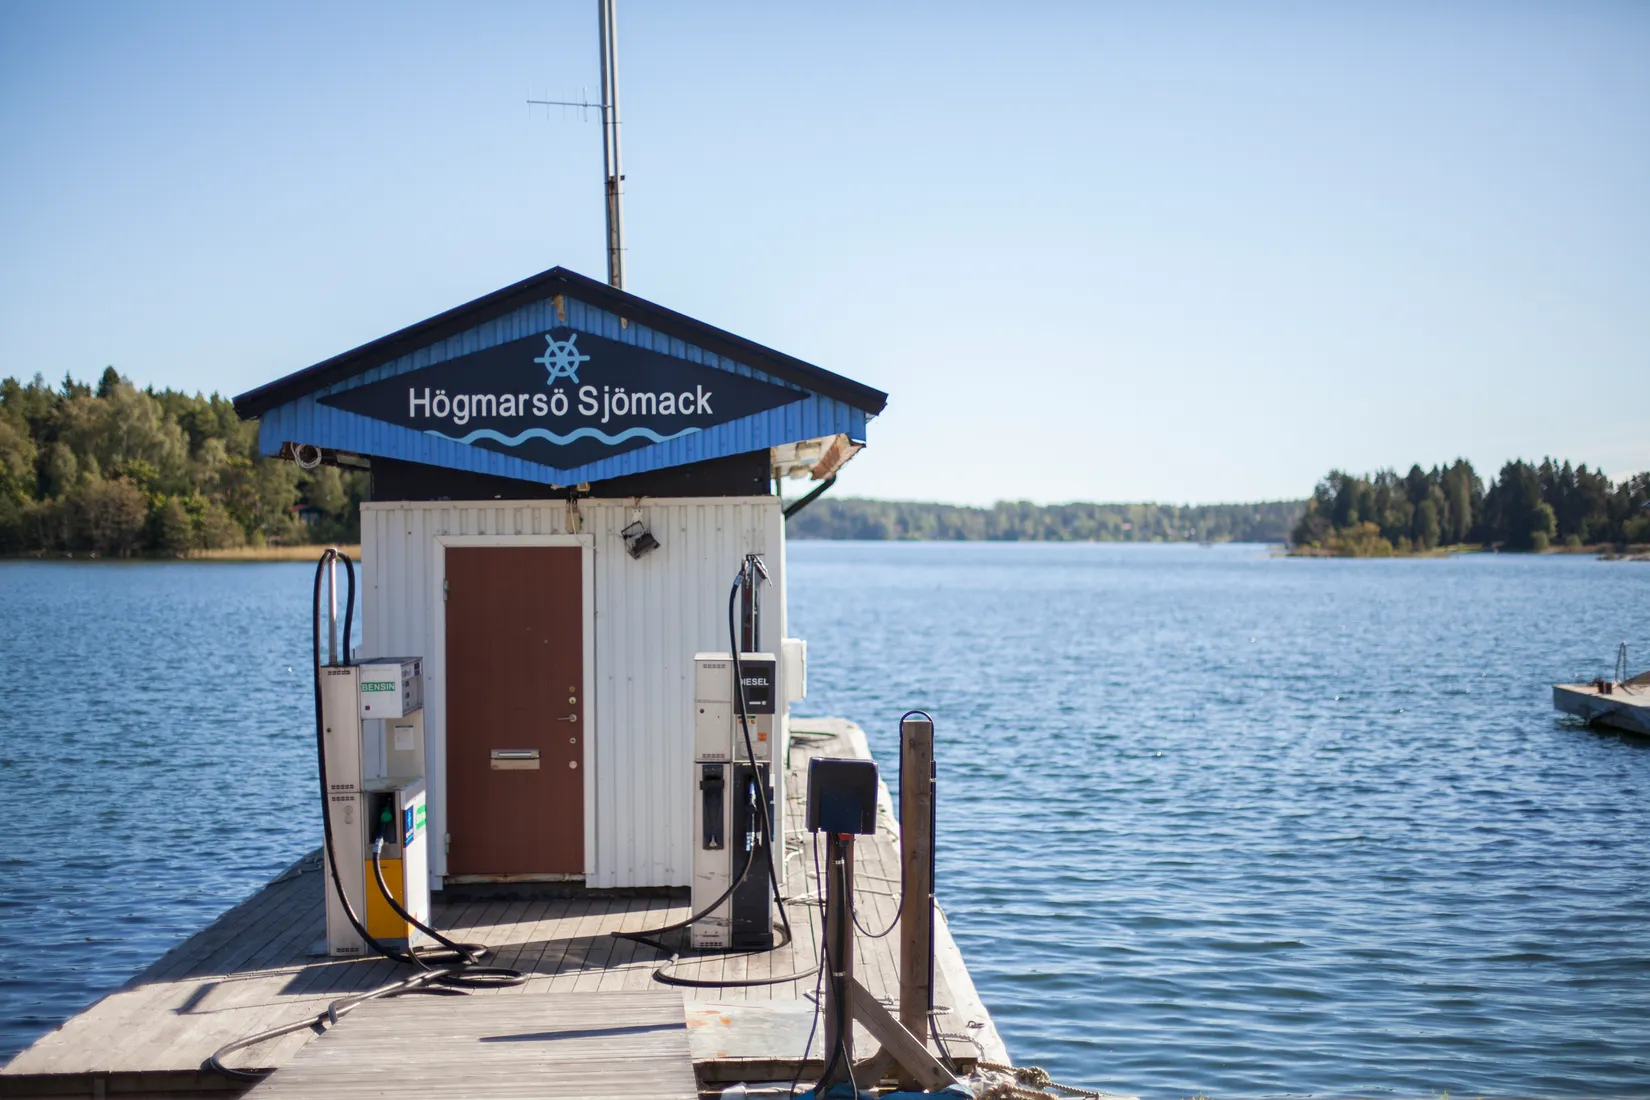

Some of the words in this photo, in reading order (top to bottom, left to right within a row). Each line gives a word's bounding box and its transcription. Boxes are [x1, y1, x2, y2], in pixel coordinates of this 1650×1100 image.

[409, 387, 569, 425] Högmarsö
[578, 384, 713, 424] Sjömack
[361, 683, 395, 691] BENSIN
